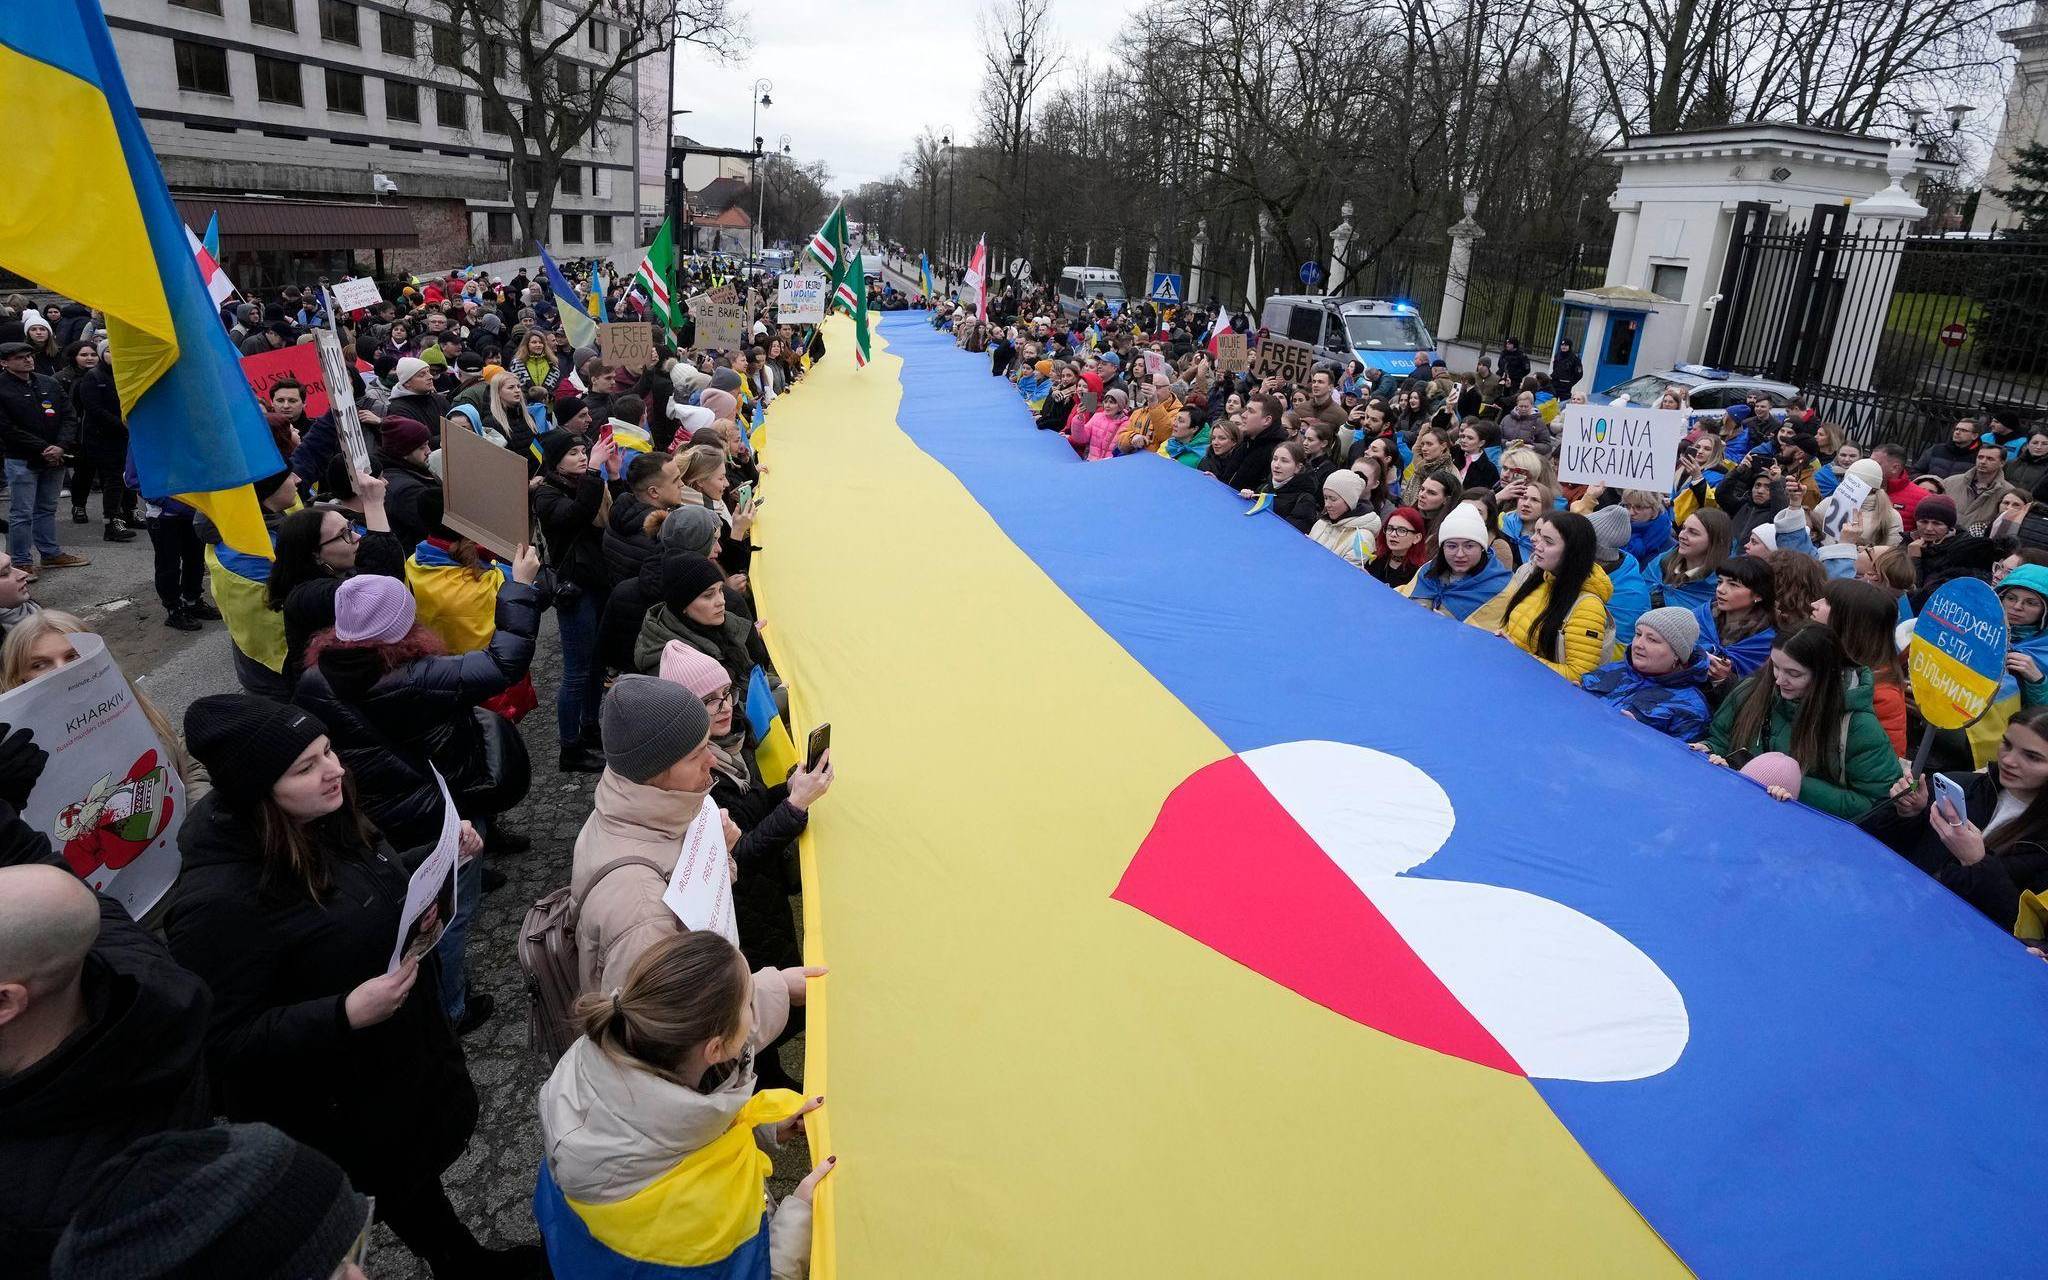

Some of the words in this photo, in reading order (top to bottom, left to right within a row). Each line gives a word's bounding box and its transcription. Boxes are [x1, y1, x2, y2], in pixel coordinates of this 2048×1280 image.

[1011, 262, 1030, 274] 30
[783, 279, 793, 290] DO
[701, 306, 714, 317] BE
[718, 307, 740, 319] BRAVE
[611, 326, 648, 344] FREE
[610, 344, 649, 360] AZOV
[1261, 341, 1309, 366] FREE
[1258, 359, 1307, 383] AZOV
[1391, 360, 1416, 368] POLI
[1580, 417, 1652, 448] WOLNA
[1567, 445, 1654, 480] UKRAINA
[1937, 631, 1973, 665] БУТИ
[65, 688, 125, 734] KHARKIV
